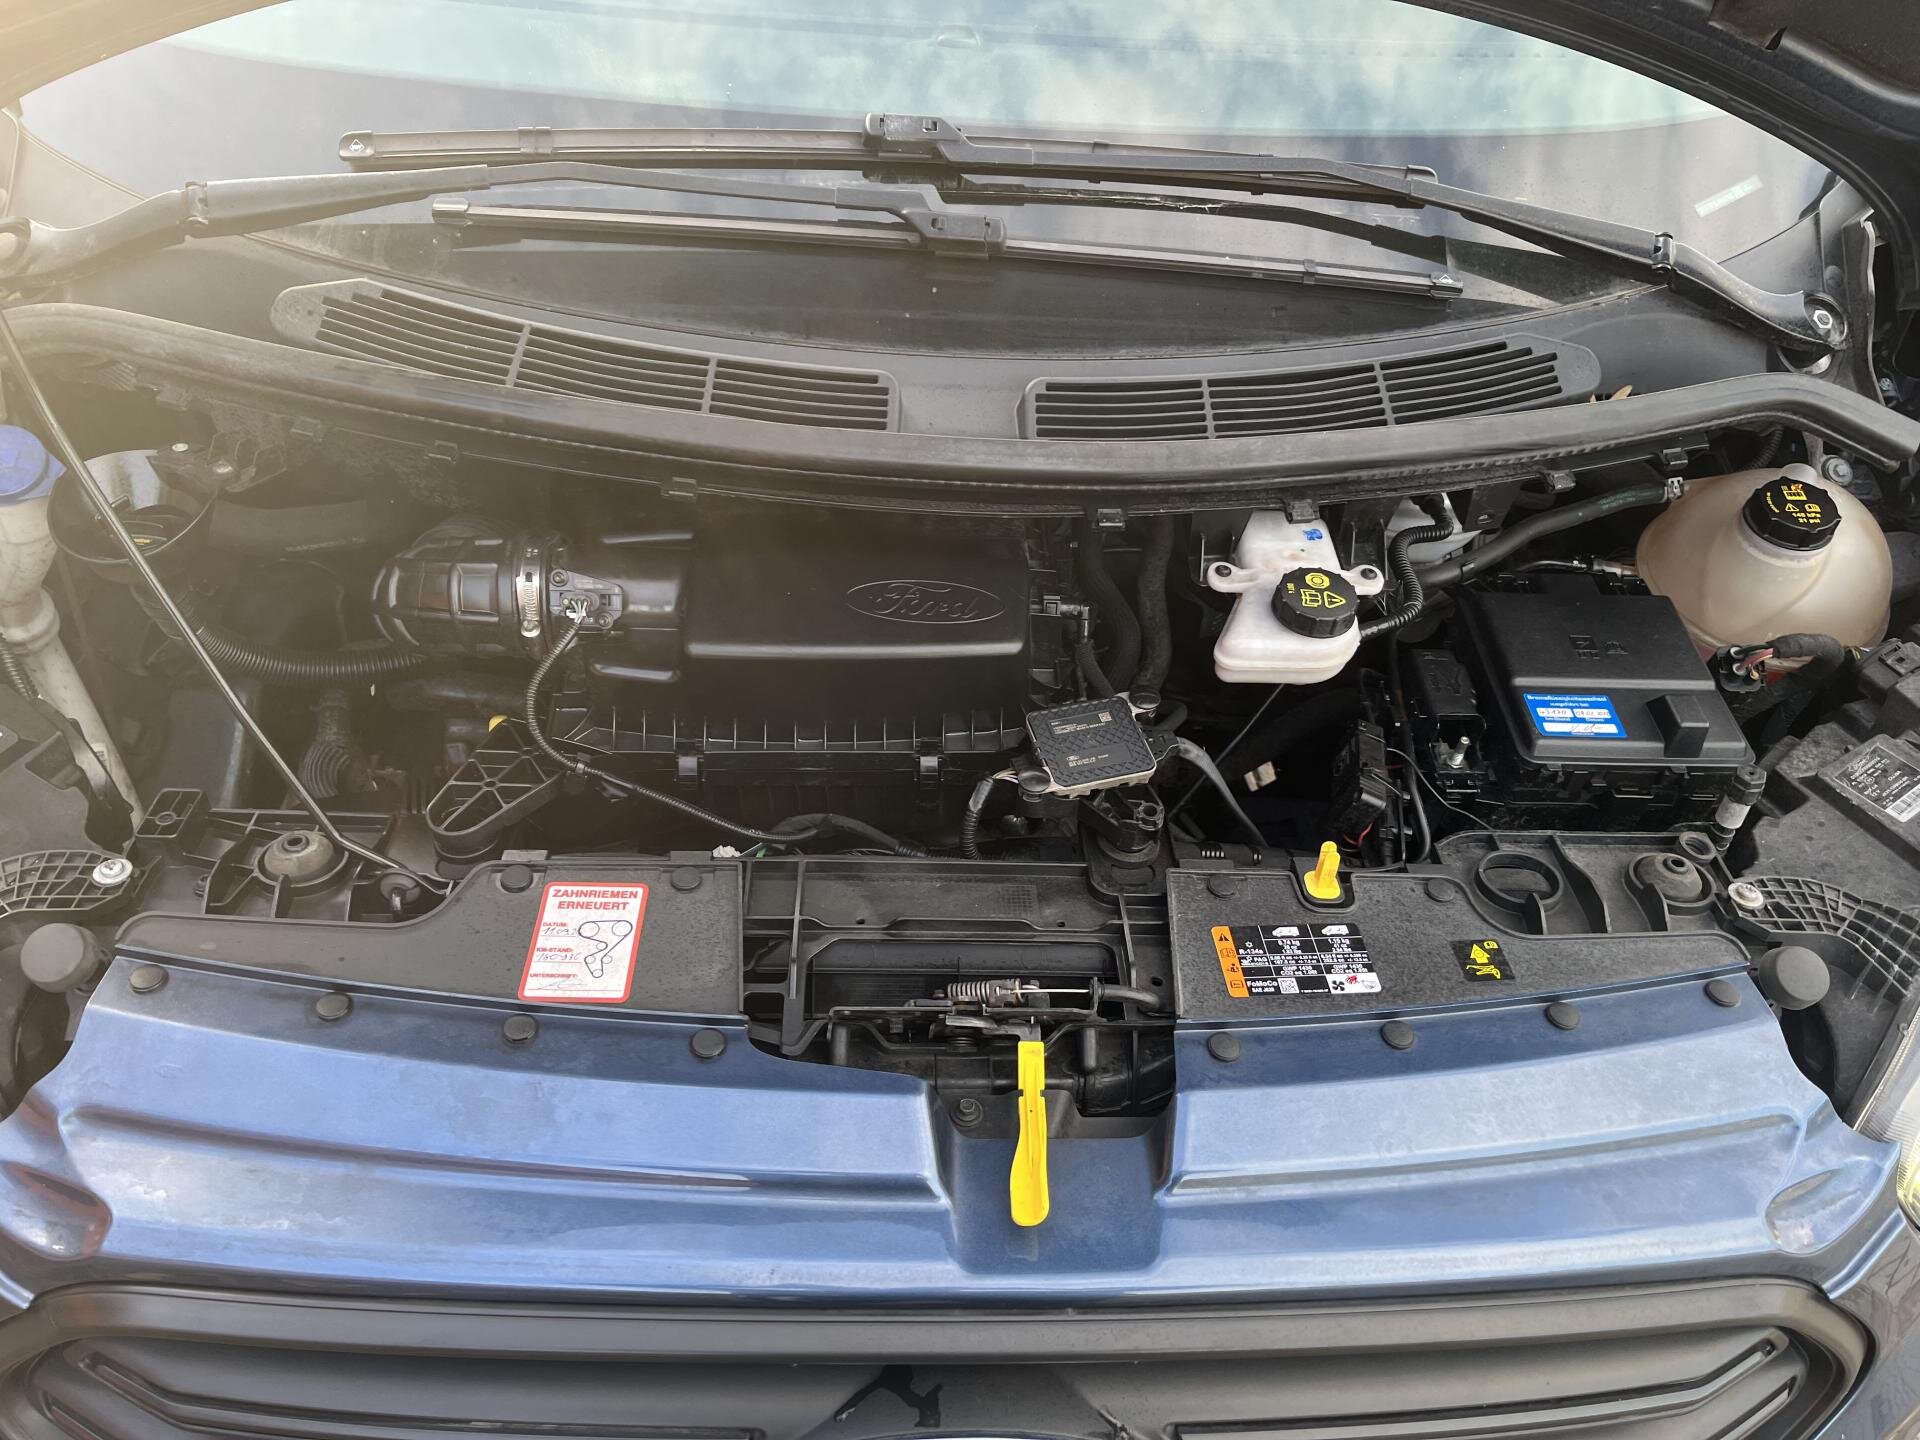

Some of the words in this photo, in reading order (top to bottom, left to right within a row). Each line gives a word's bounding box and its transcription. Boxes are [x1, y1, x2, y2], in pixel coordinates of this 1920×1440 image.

[873, 583, 978, 618] Ford
[552, 889, 638, 899] ZAHNRIEMEN
[557, 901, 629, 910] ERNEUERT
